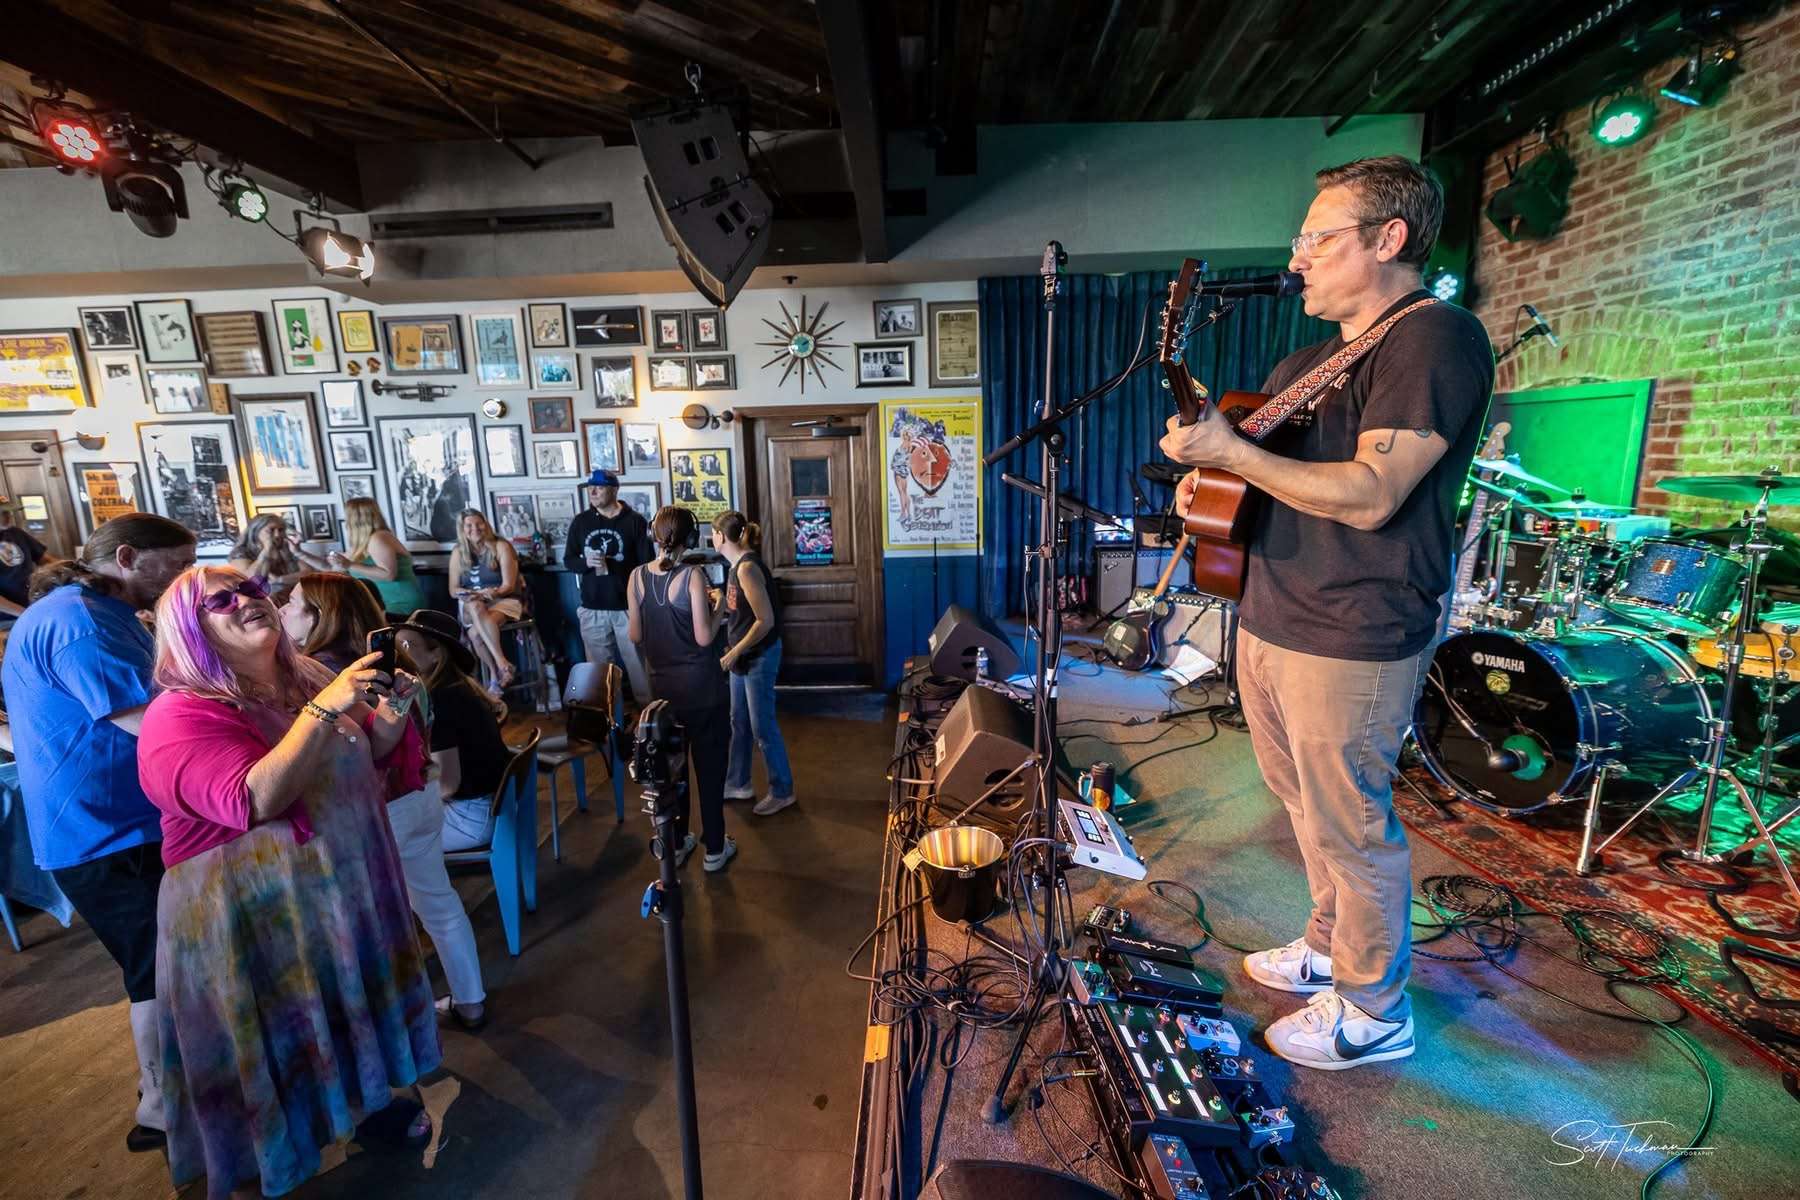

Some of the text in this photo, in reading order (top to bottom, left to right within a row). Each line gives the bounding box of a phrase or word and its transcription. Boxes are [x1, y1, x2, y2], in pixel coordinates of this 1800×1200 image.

[92, 497, 134, 507] COLTRA
[497, 496, 511, 504] LIFE
[1484, 654, 1525, 673] YAMAHA
